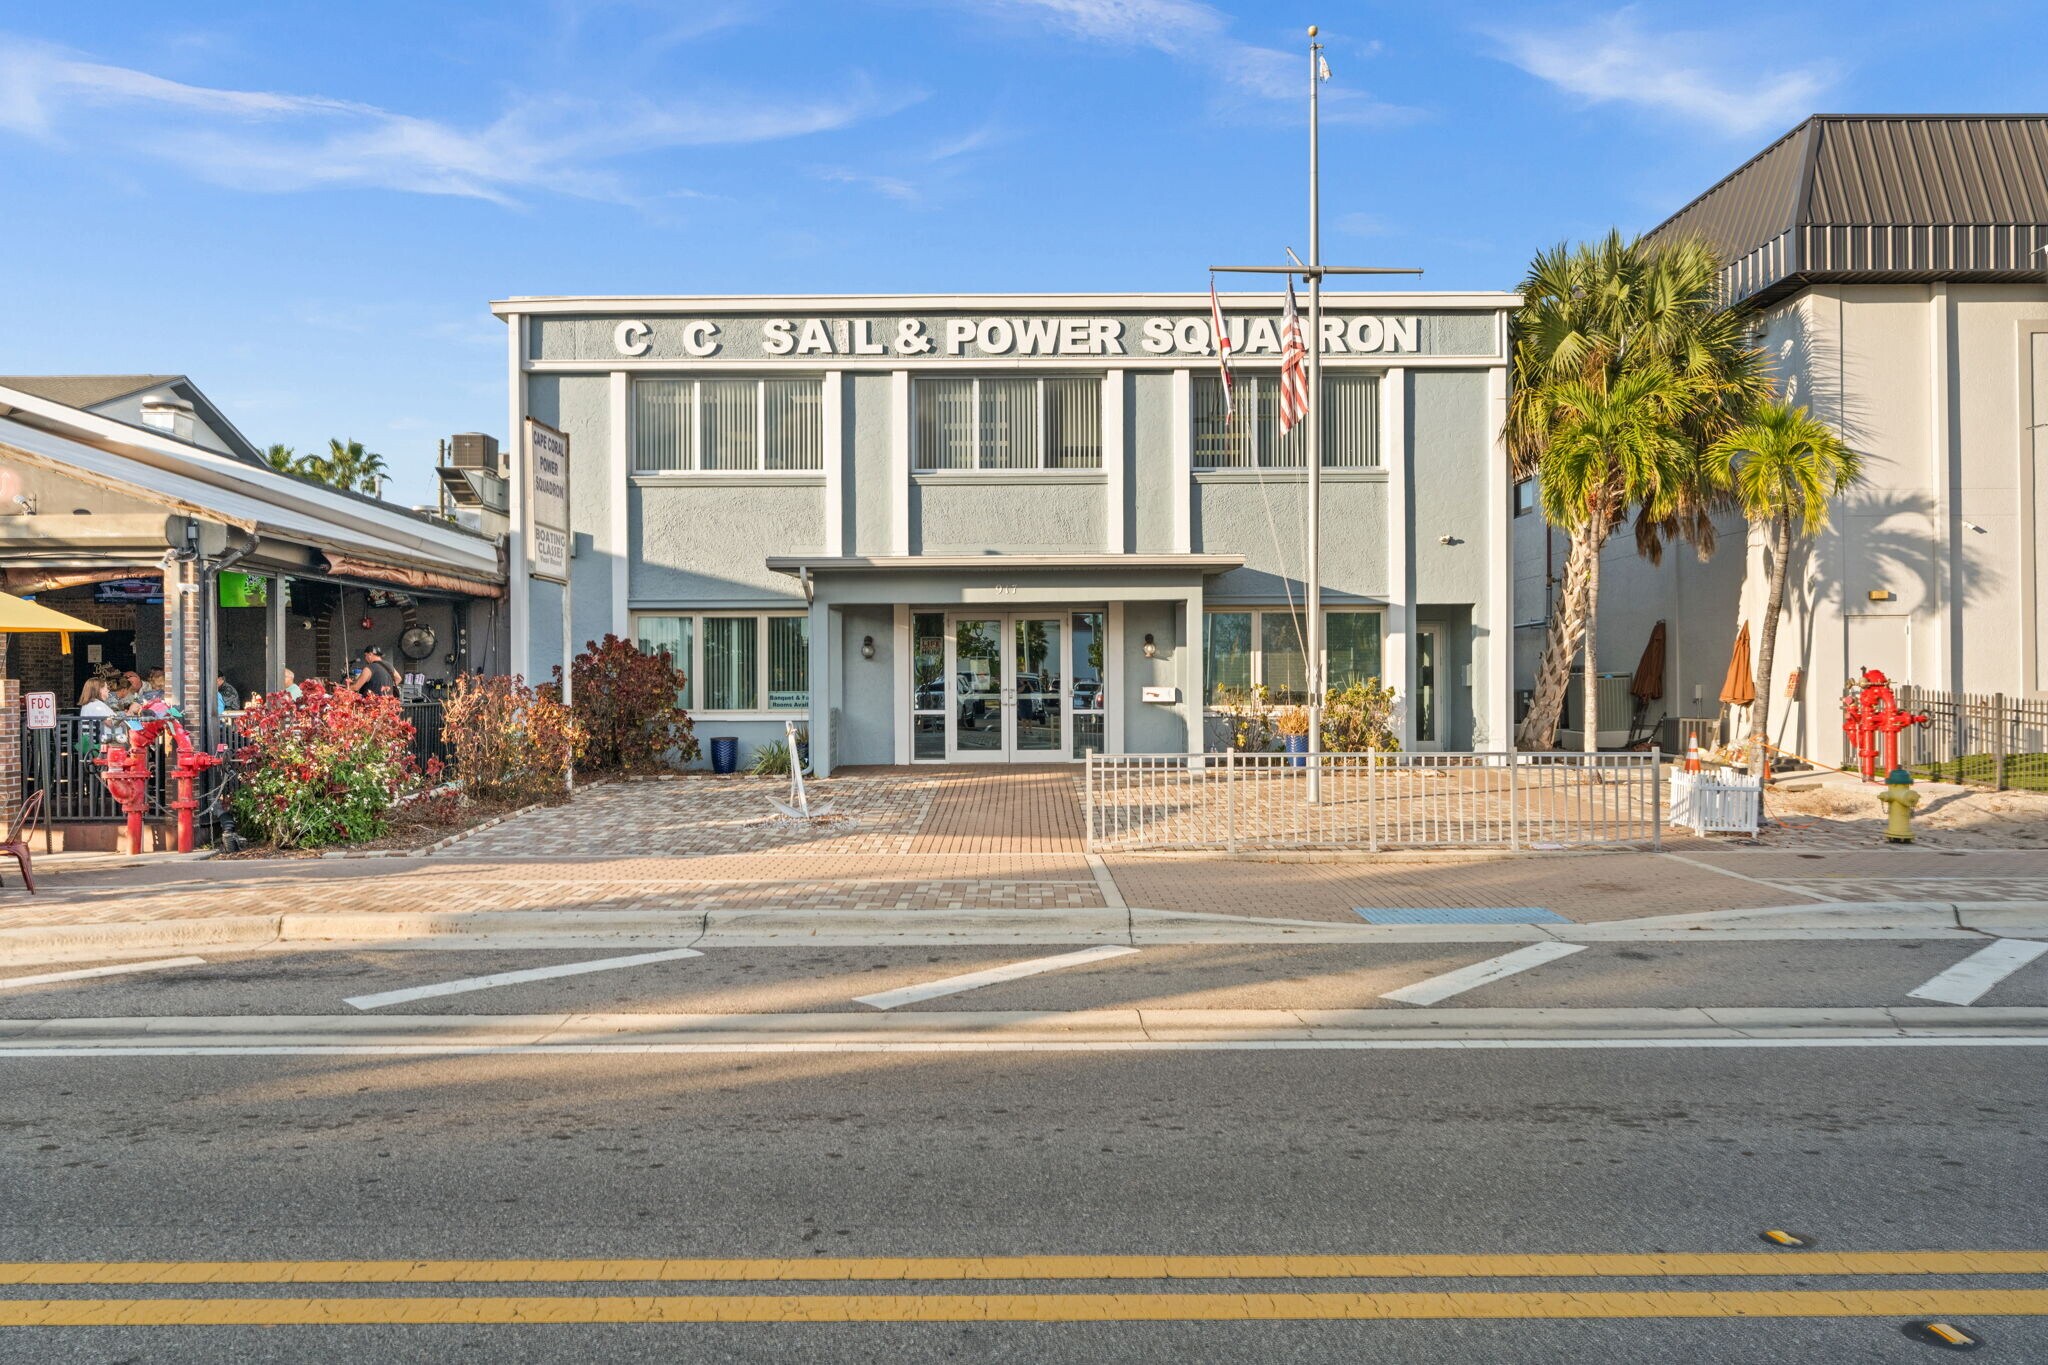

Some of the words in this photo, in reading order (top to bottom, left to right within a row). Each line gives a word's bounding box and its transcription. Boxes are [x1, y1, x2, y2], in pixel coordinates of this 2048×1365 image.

[614, 320, 648, 356] C
[682, 320, 717, 356] C
[763, 319, 883, 355] SAIL
[894, 318, 931, 354] &
[946, 318, 1123, 354] POWER
[534, 430, 547, 450] CAPE
[548, 437, 564, 457] CORAL
[540, 455, 559, 476] POWER
[535, 475, 564, 499] SQUADRON
[535, 527, 565, 547] BOATING
[538, 541, 563, 558] CLASSES
[31, 697, 51, 709] FDC
